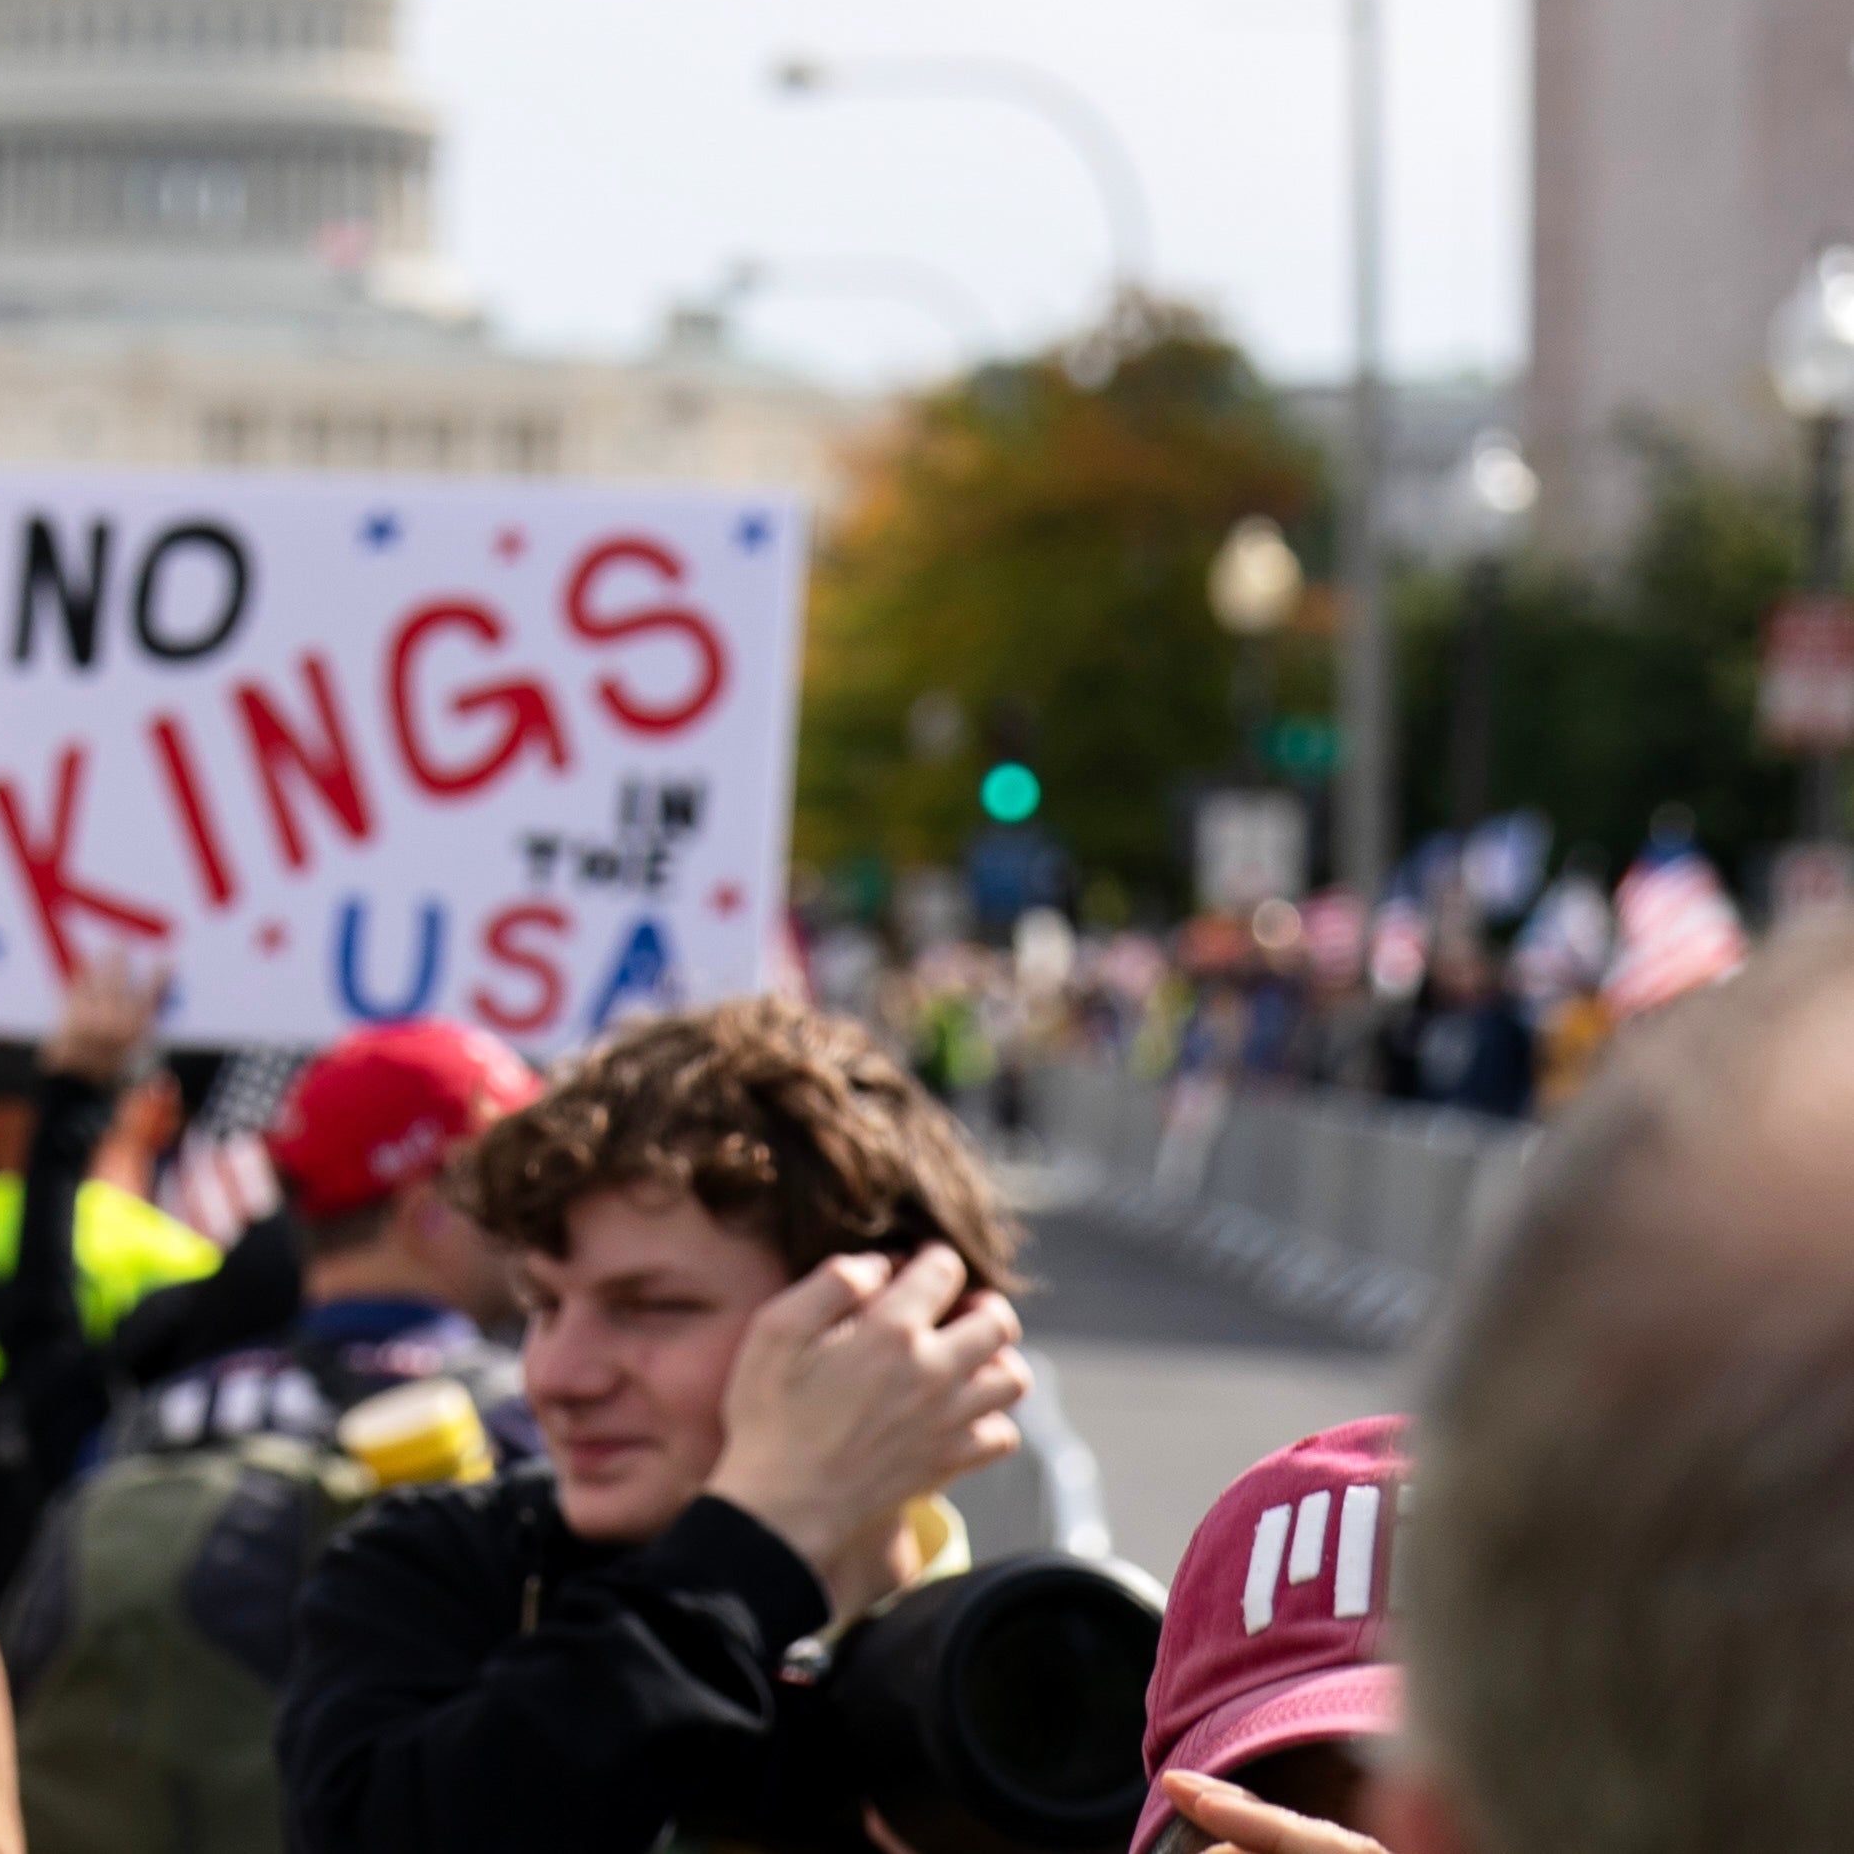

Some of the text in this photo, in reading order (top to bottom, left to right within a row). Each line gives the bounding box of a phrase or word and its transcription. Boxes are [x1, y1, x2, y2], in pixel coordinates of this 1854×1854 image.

[12, 510, 255, 672] NO
[620, 774, 707, 838] IN
[336, 894, 680, 1036] USA
